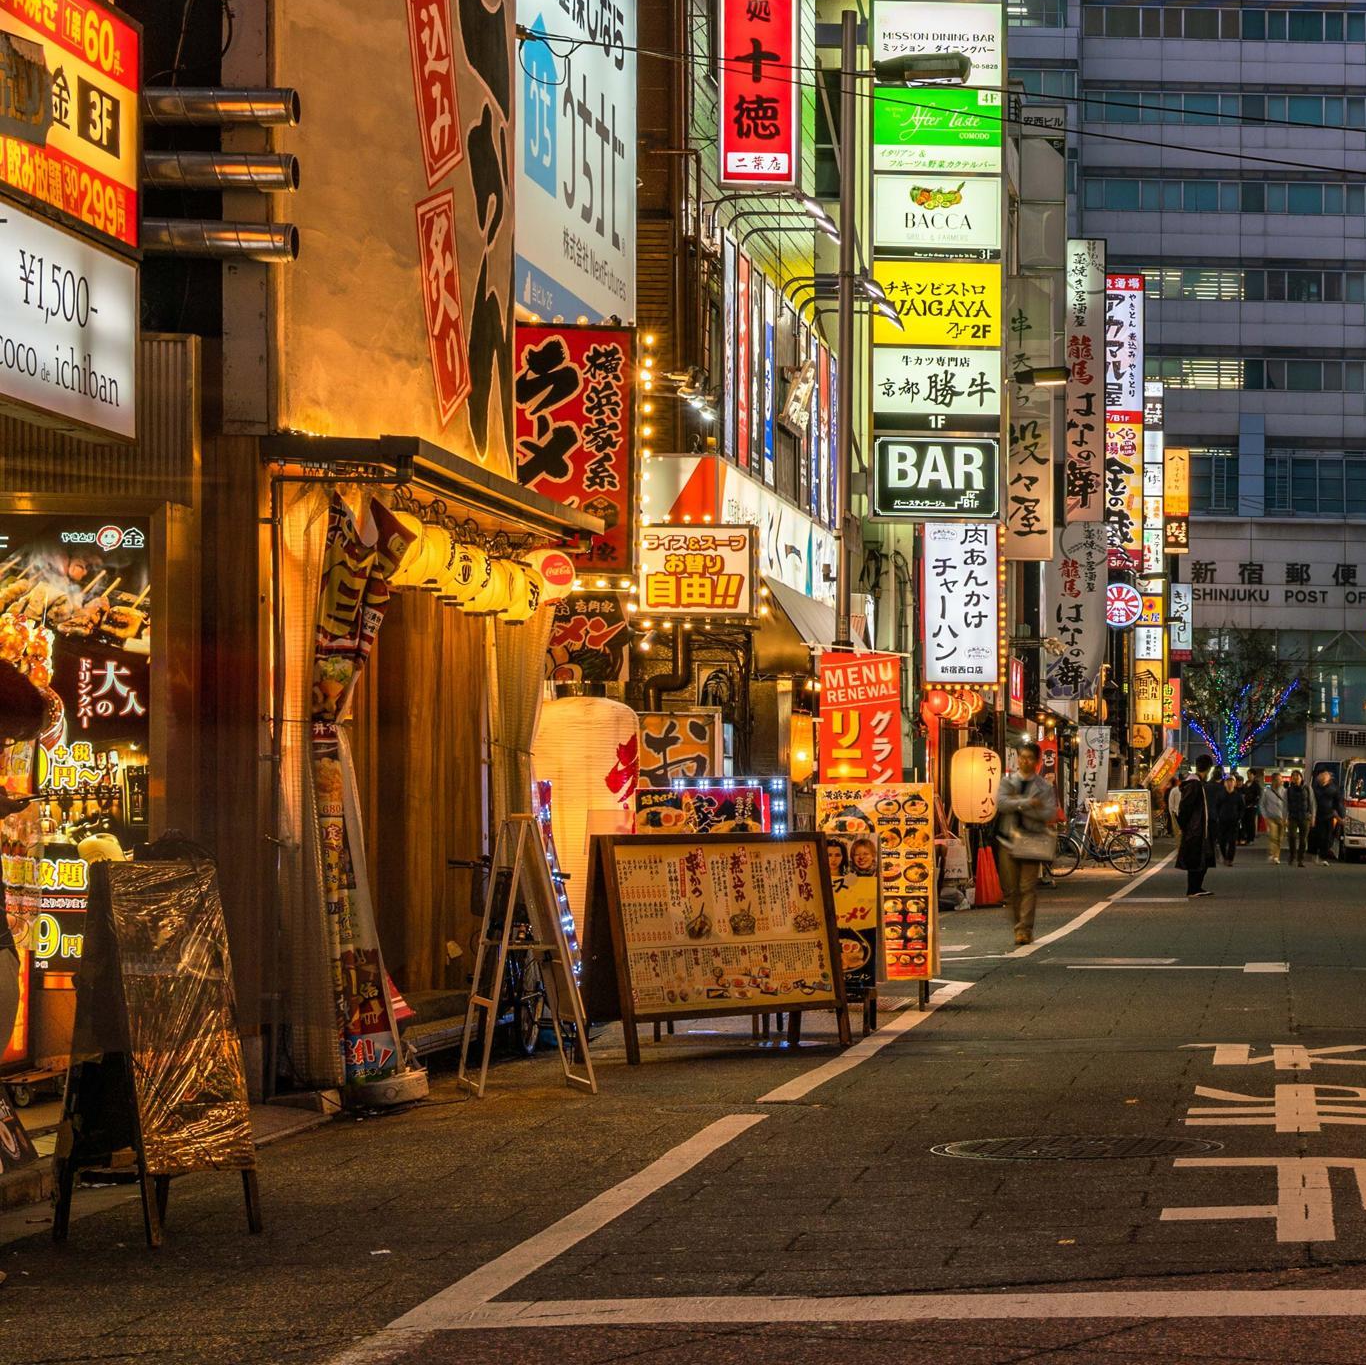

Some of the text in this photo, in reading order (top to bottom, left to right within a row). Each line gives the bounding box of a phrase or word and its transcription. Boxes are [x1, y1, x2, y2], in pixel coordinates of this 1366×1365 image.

[84, 9, 115, 71] 60
[883, 32, 995, 43] MISSION DINING BAR
[883, 44, 926, 53] ミッション
[733, 38, 781, 140] 十徳
[981, 92, 998, 105] 4F
[89, 89, 113, 146] 3F
[735, 156, 783, 172] 二葉店
[905, 212, 972, 230] BACCA
[884, 282, 986, 296] チキンビストロ
[971, 324, 992, 339] 2F
[901, 355, 970, 368] 牛カツ専門店
[55, 344, 120, 407] ichiban
[584, 343, 625, 493] 横浜家系
[928, 414, 946, 429] 1F
[1067, 393, 1101, 508] はなの舞
[887, 444, 985, 490] BAR
[643, 534, 747, 552] ライス&スープ
[664, 553, 724, 575] お替り
[960, 527, 990, 629] 肉あんかけ
[647, 574, 745, 609] 自由!!
[1192, 587, 1328, 604] SHINJUKU POST
[932, 557, 959, 662] チャーハン
[825, 661, 893, 689] MENU
[827, 681, 897, 703] RENEWAL
[979, 751, 997, 819] チャーハン
